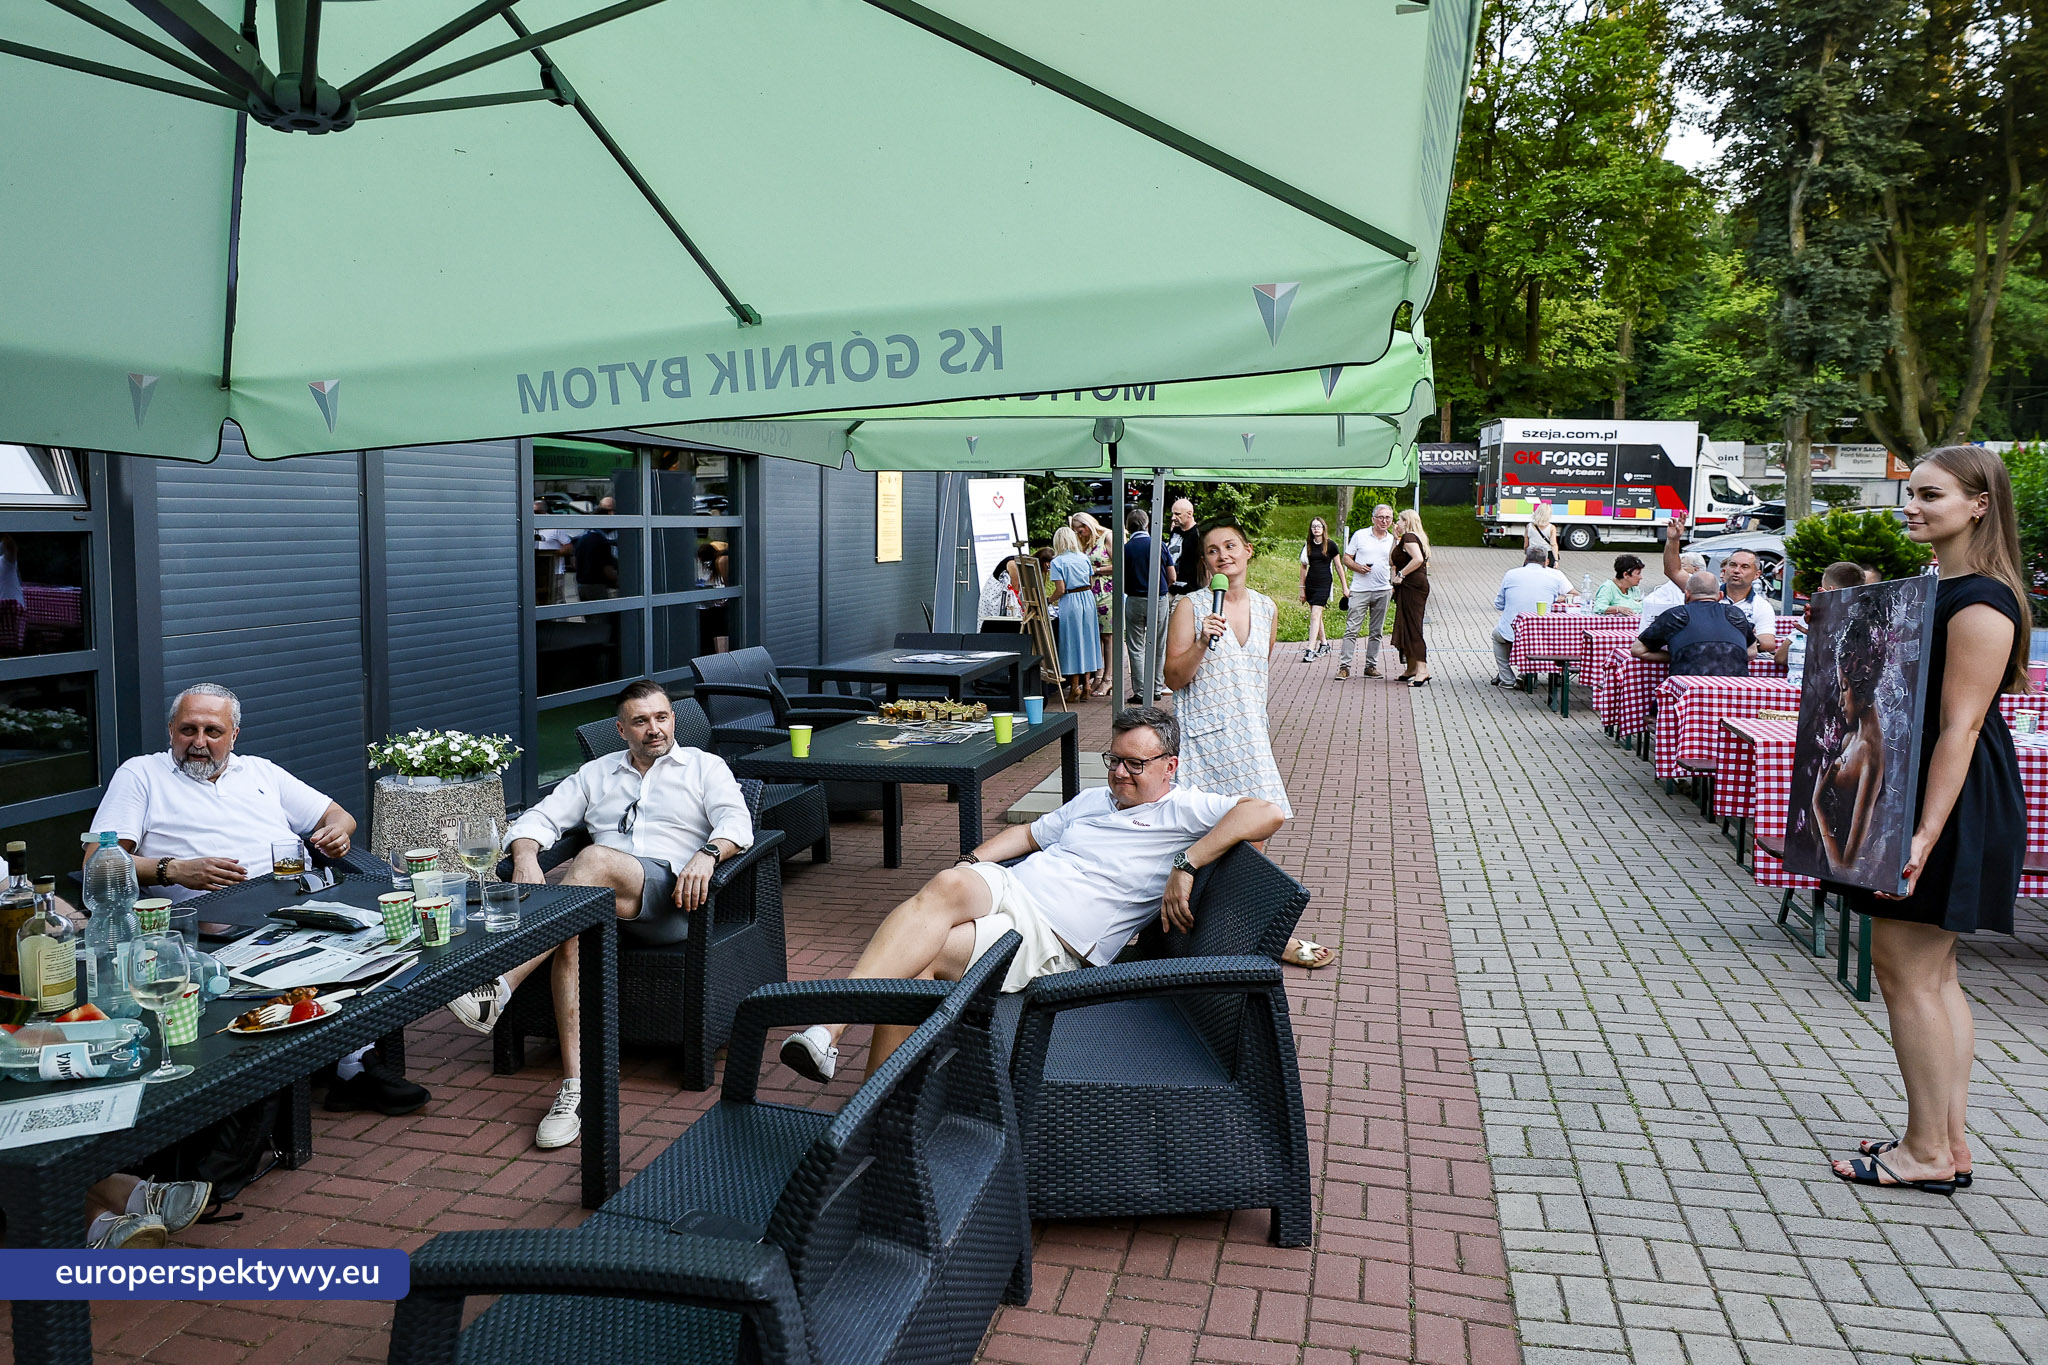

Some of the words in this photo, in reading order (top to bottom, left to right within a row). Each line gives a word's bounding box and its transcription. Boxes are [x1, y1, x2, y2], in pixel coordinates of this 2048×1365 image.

[1522, 429, 1618, 441] szeja.com.pl
[1418, 450, 1477, 461] ETORN
[1513, 450, 1609, 467] GKFORGE
